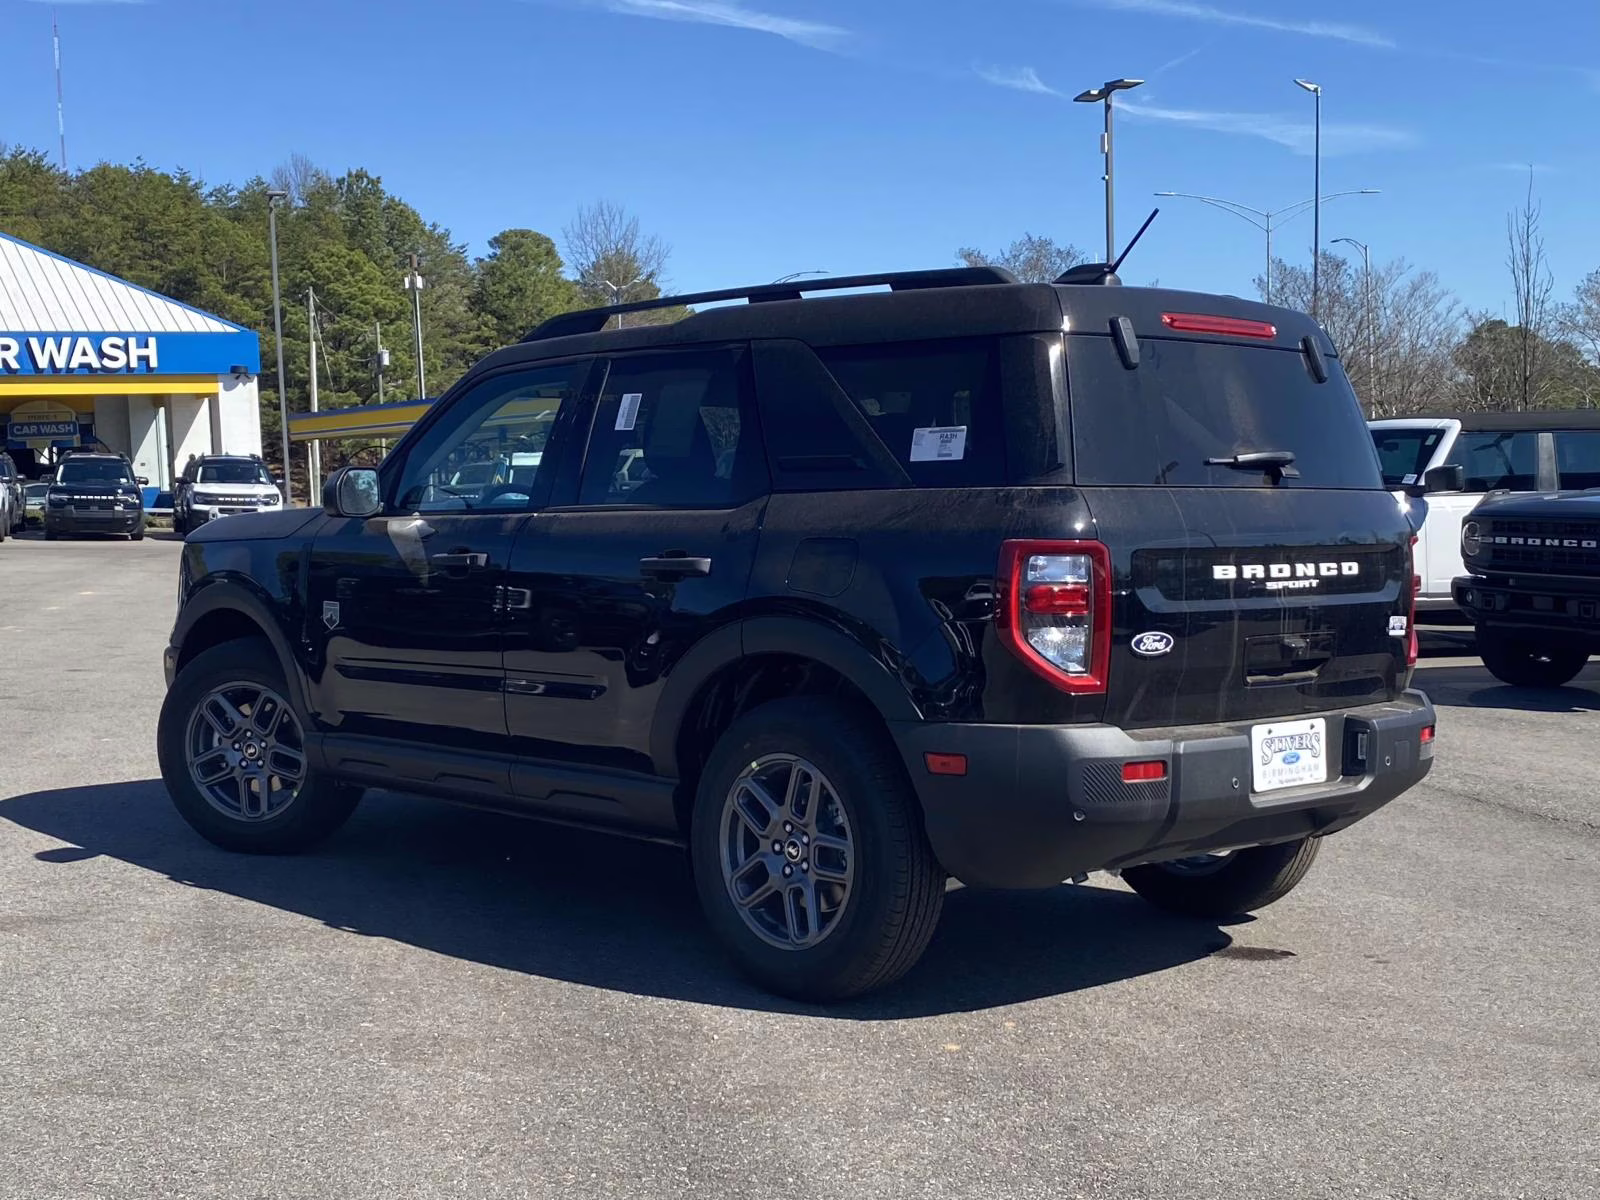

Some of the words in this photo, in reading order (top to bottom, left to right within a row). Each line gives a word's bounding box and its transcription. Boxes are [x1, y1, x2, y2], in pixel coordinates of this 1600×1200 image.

[28, 336, 158, 369] WASH
[13, 425, 38, 435] CAR
[40, 424, 74, 433] WASH
[1494, 536, 1597, 548] BRONCO
[1212, 561, 1359, 580] BRONCO
[1265, 579, 1320, 590] SPORT
[1139, 635, 1167, 650] Ford
[1261, 731, 1321, 766] STIVERS
